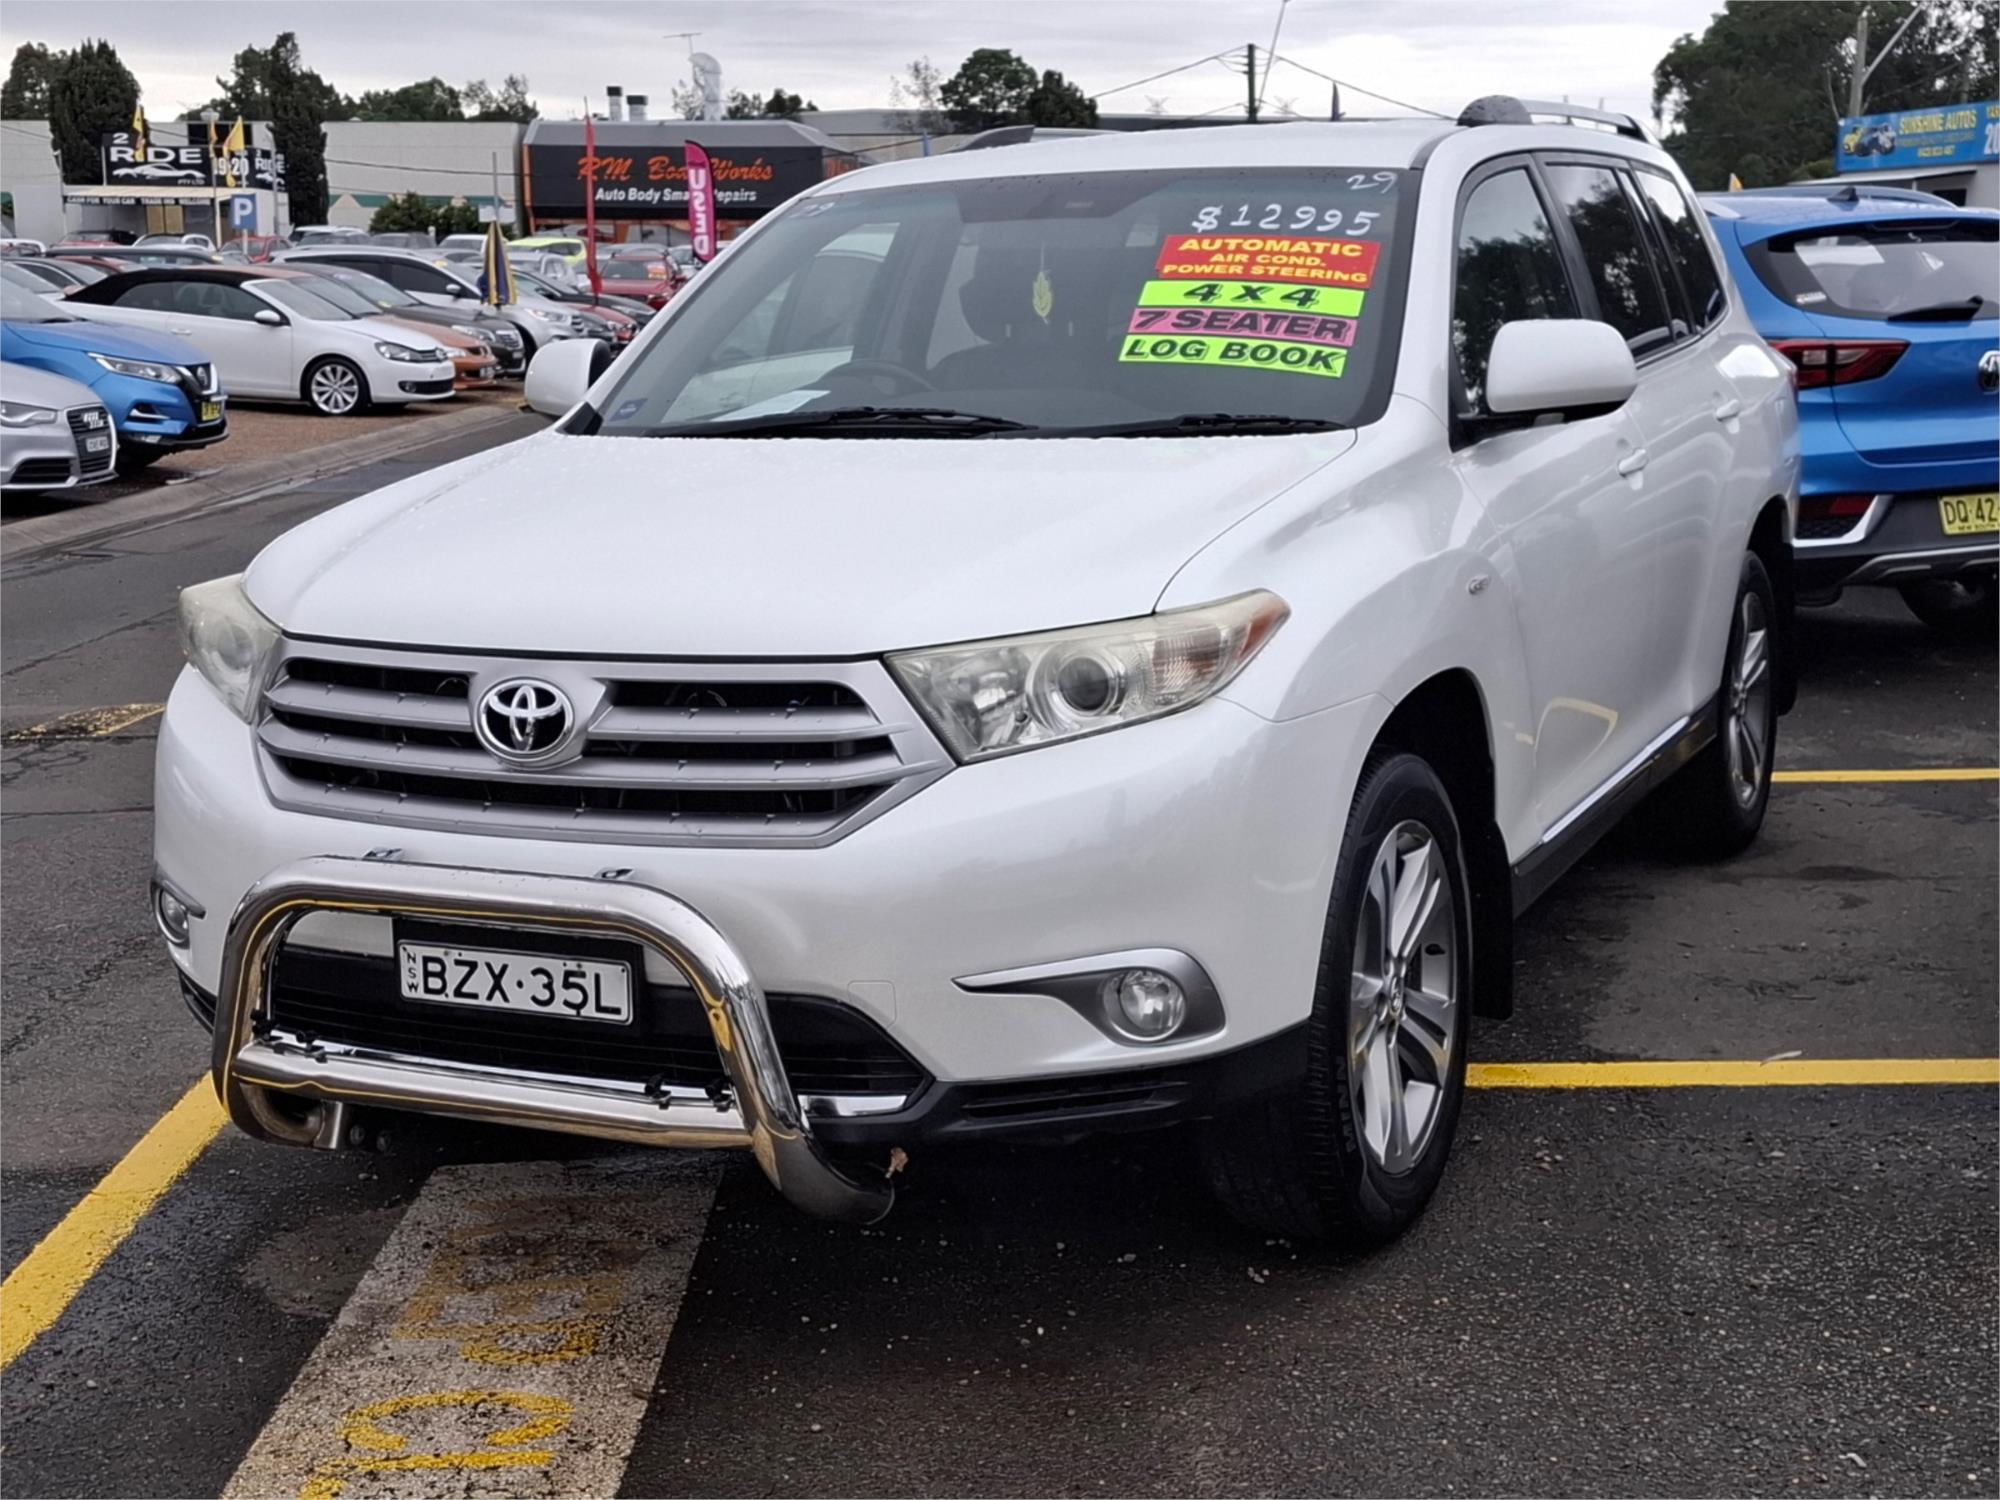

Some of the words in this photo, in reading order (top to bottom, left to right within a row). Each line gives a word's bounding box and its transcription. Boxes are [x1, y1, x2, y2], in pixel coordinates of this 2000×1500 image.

[112, 132, 129, 144] 2
[110, 147, 203, 163] RDE
[1346, 171, 1398, 194] 29
[595, 187, 626, 201] Auto
[628, 187, 661, 205] Body
[714, 187, 757, 204] epairs
[234, 198, 252, 225] P
[1191, 203, 1380, 236] $12995
[1178, 238, 1363, 257] AUTOMATIC
[1210, 253, 1249, 264] AIR
[1255, 254, 1327, 267] COND.
[1162, 264, 1245, 276] POWER
[1250, 265, 1368, 284] STEERING
[1134, 311, 1169, 330] 7
[1170, 310, 1351, 341] SEATER
[1125, 339, 1210, 360] LOG
[1218, 342, 1347, 374] BOOK
[407, 952, 419, 993] NSW
